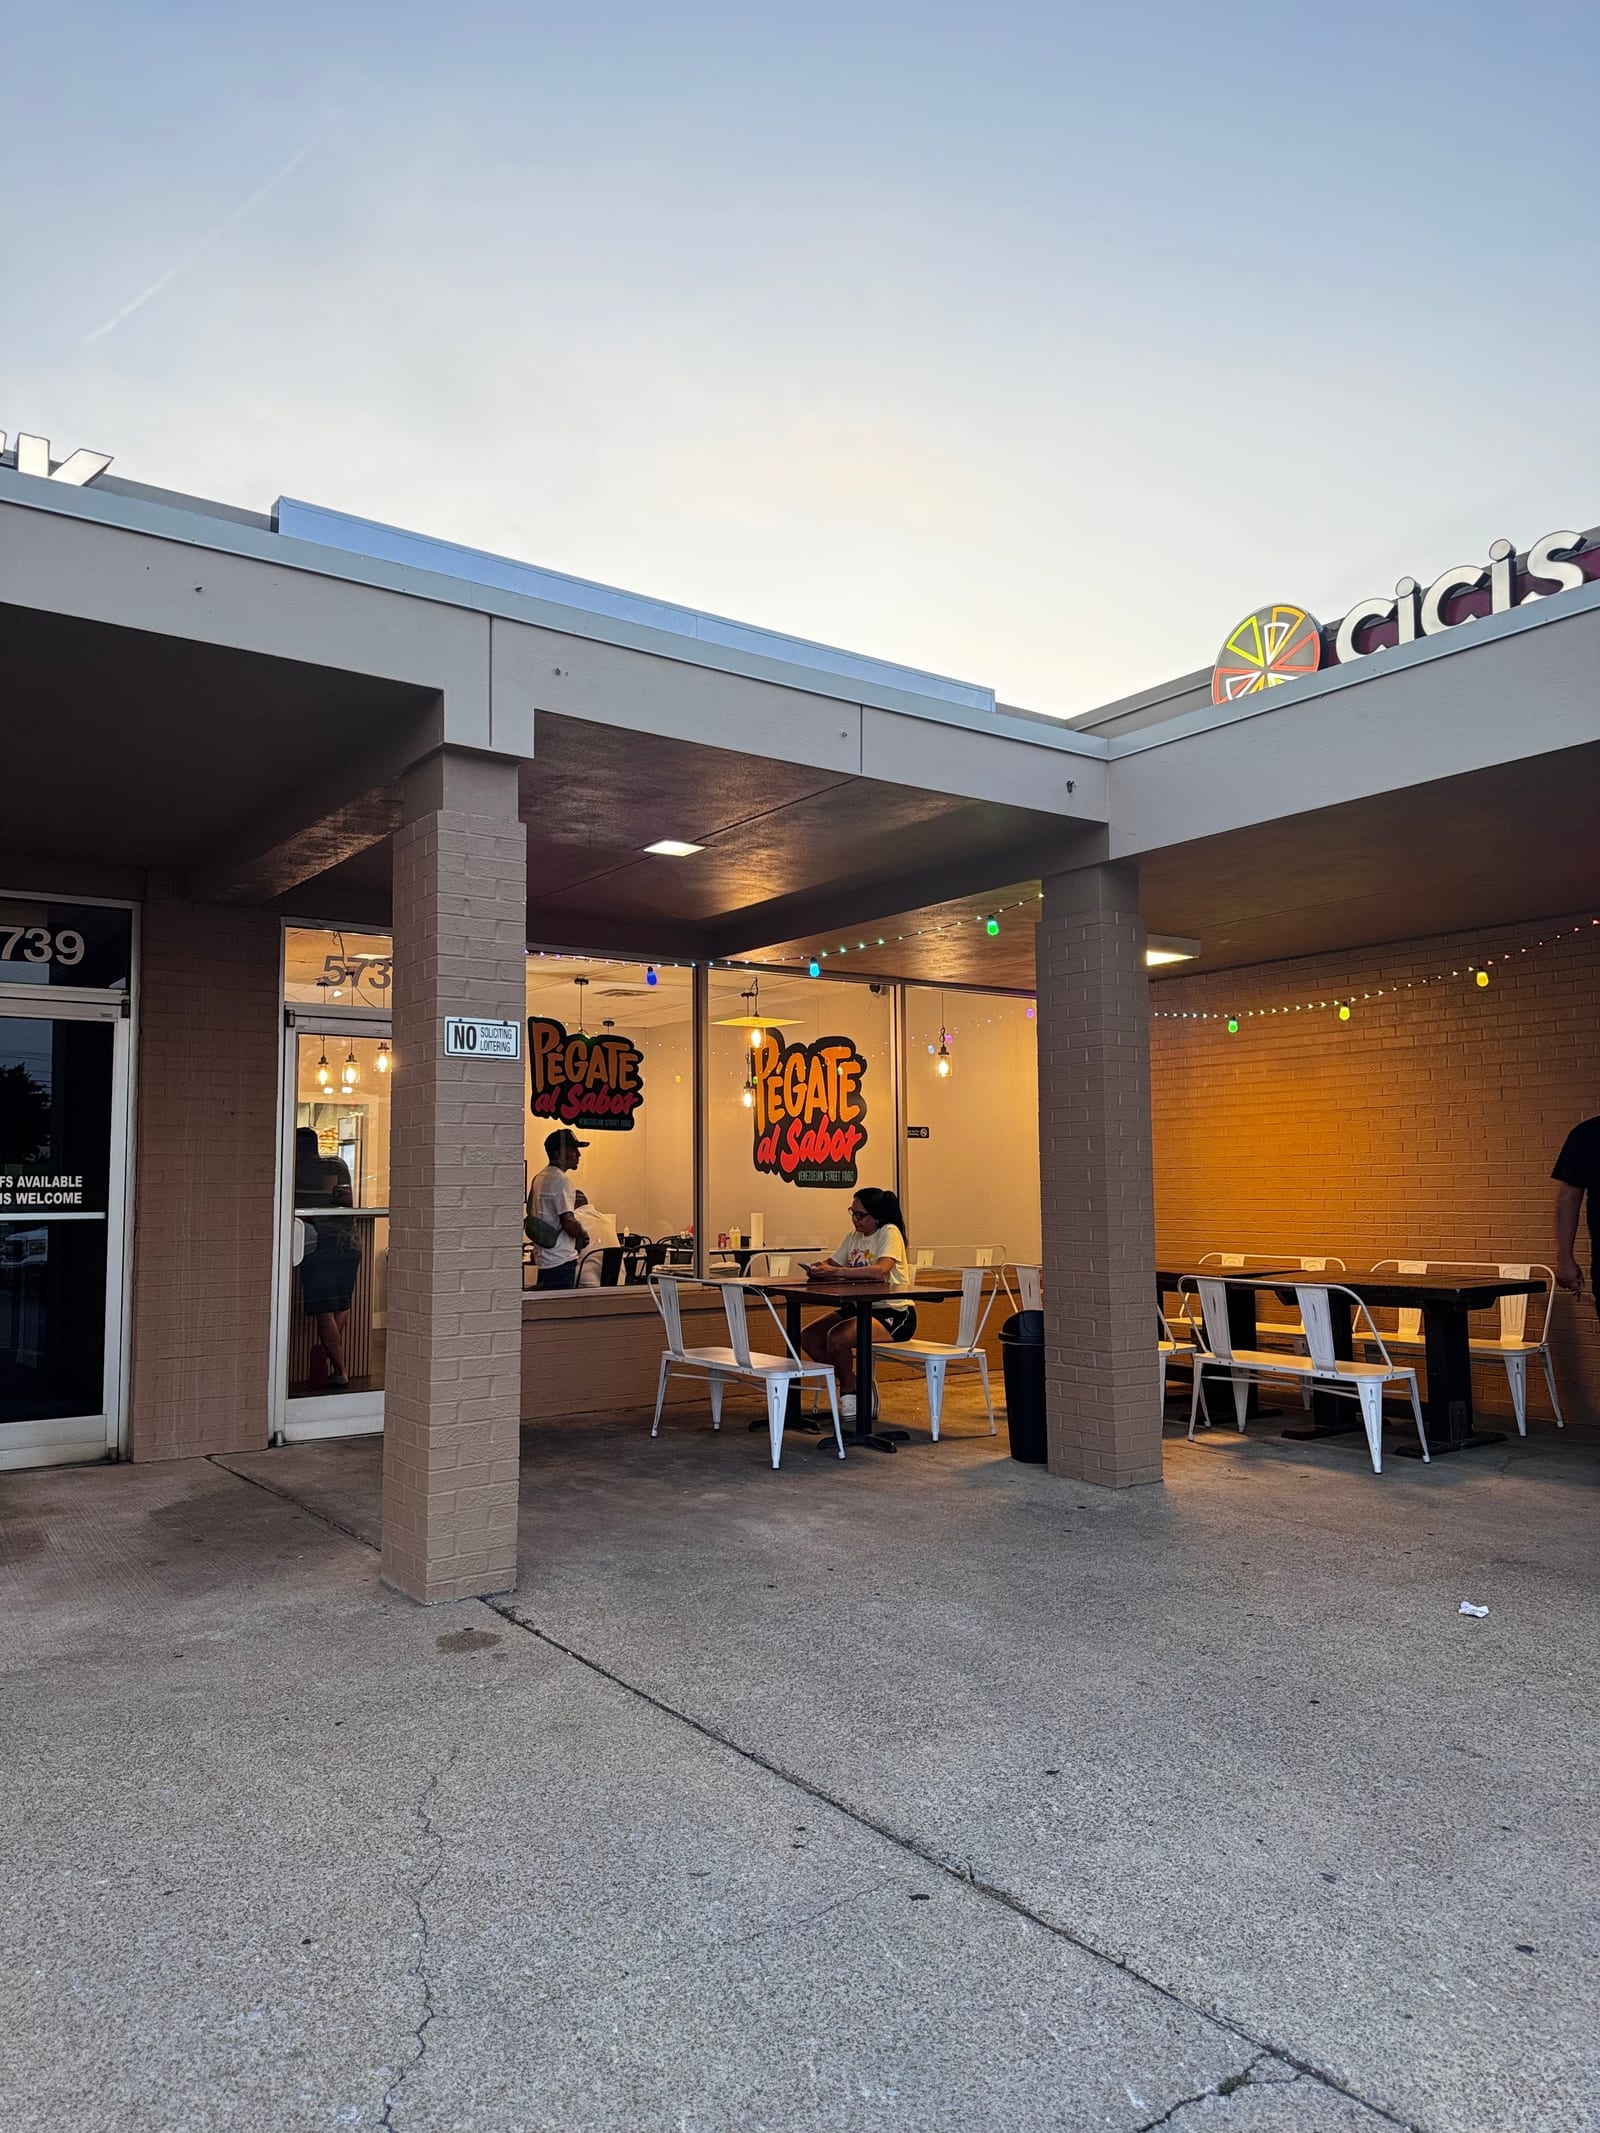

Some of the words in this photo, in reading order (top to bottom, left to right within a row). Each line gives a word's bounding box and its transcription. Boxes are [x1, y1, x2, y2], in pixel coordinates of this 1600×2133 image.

[1336, 530, 1588, 664] cicis
[454, 1025, 477, 1050] NO
[480, 1026, 513, 1040] SOLICITING
[480, 1040, 511, 1053] LOITERING
[532, 1022, 639, 1092] PÉGATE
[754, 1034, 861, 1137] PÉGATE
[535, 1085, 561, 1113] al
[560, 1083, 639, 1119] Sabor
[757, 1123, 781, 1164] al
[780, 1114, 862, 1173] Sabor
[16, 1175, 83, 1188] AVAILABLE
[15, 1192, 82, 1205] WELCOME
